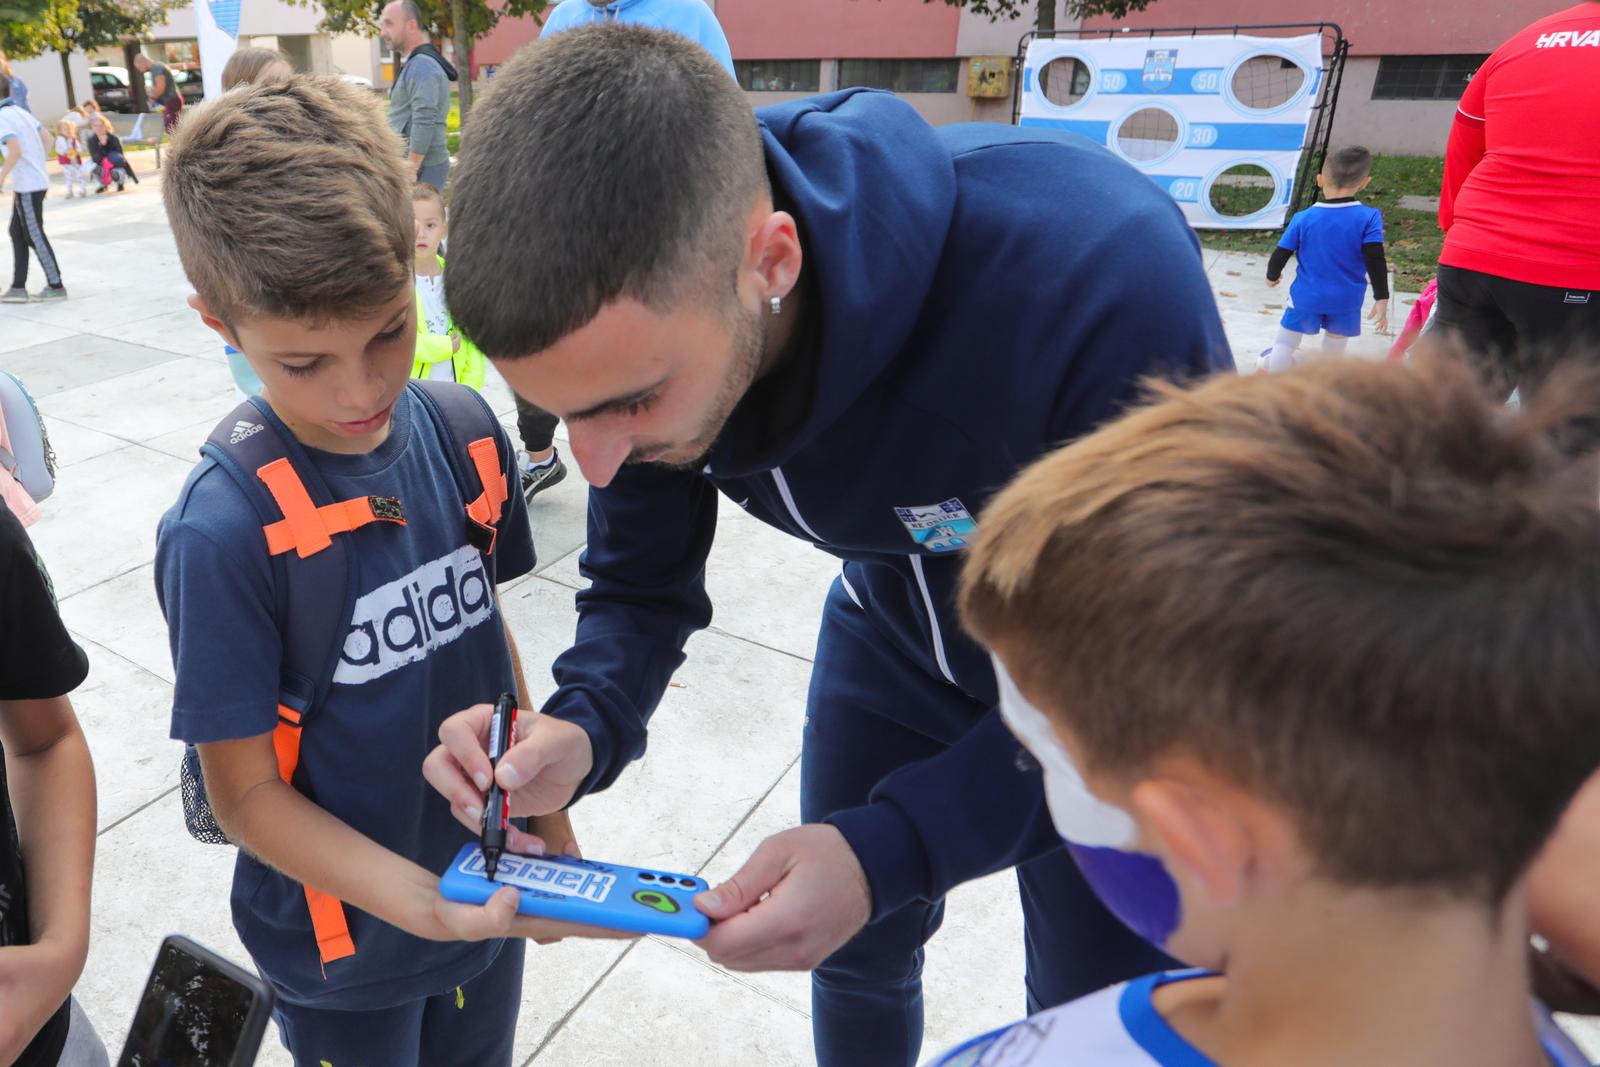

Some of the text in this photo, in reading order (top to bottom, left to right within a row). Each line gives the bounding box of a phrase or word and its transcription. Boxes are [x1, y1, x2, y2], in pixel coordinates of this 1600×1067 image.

[1103, 73, 1120, 90] 50
[1198, 73, 1217, 90] 50
[1192, 127, 1212, 144] 30
[1175, 182, 1194, 199] 20
[230, 424, 264, 444] adidas
